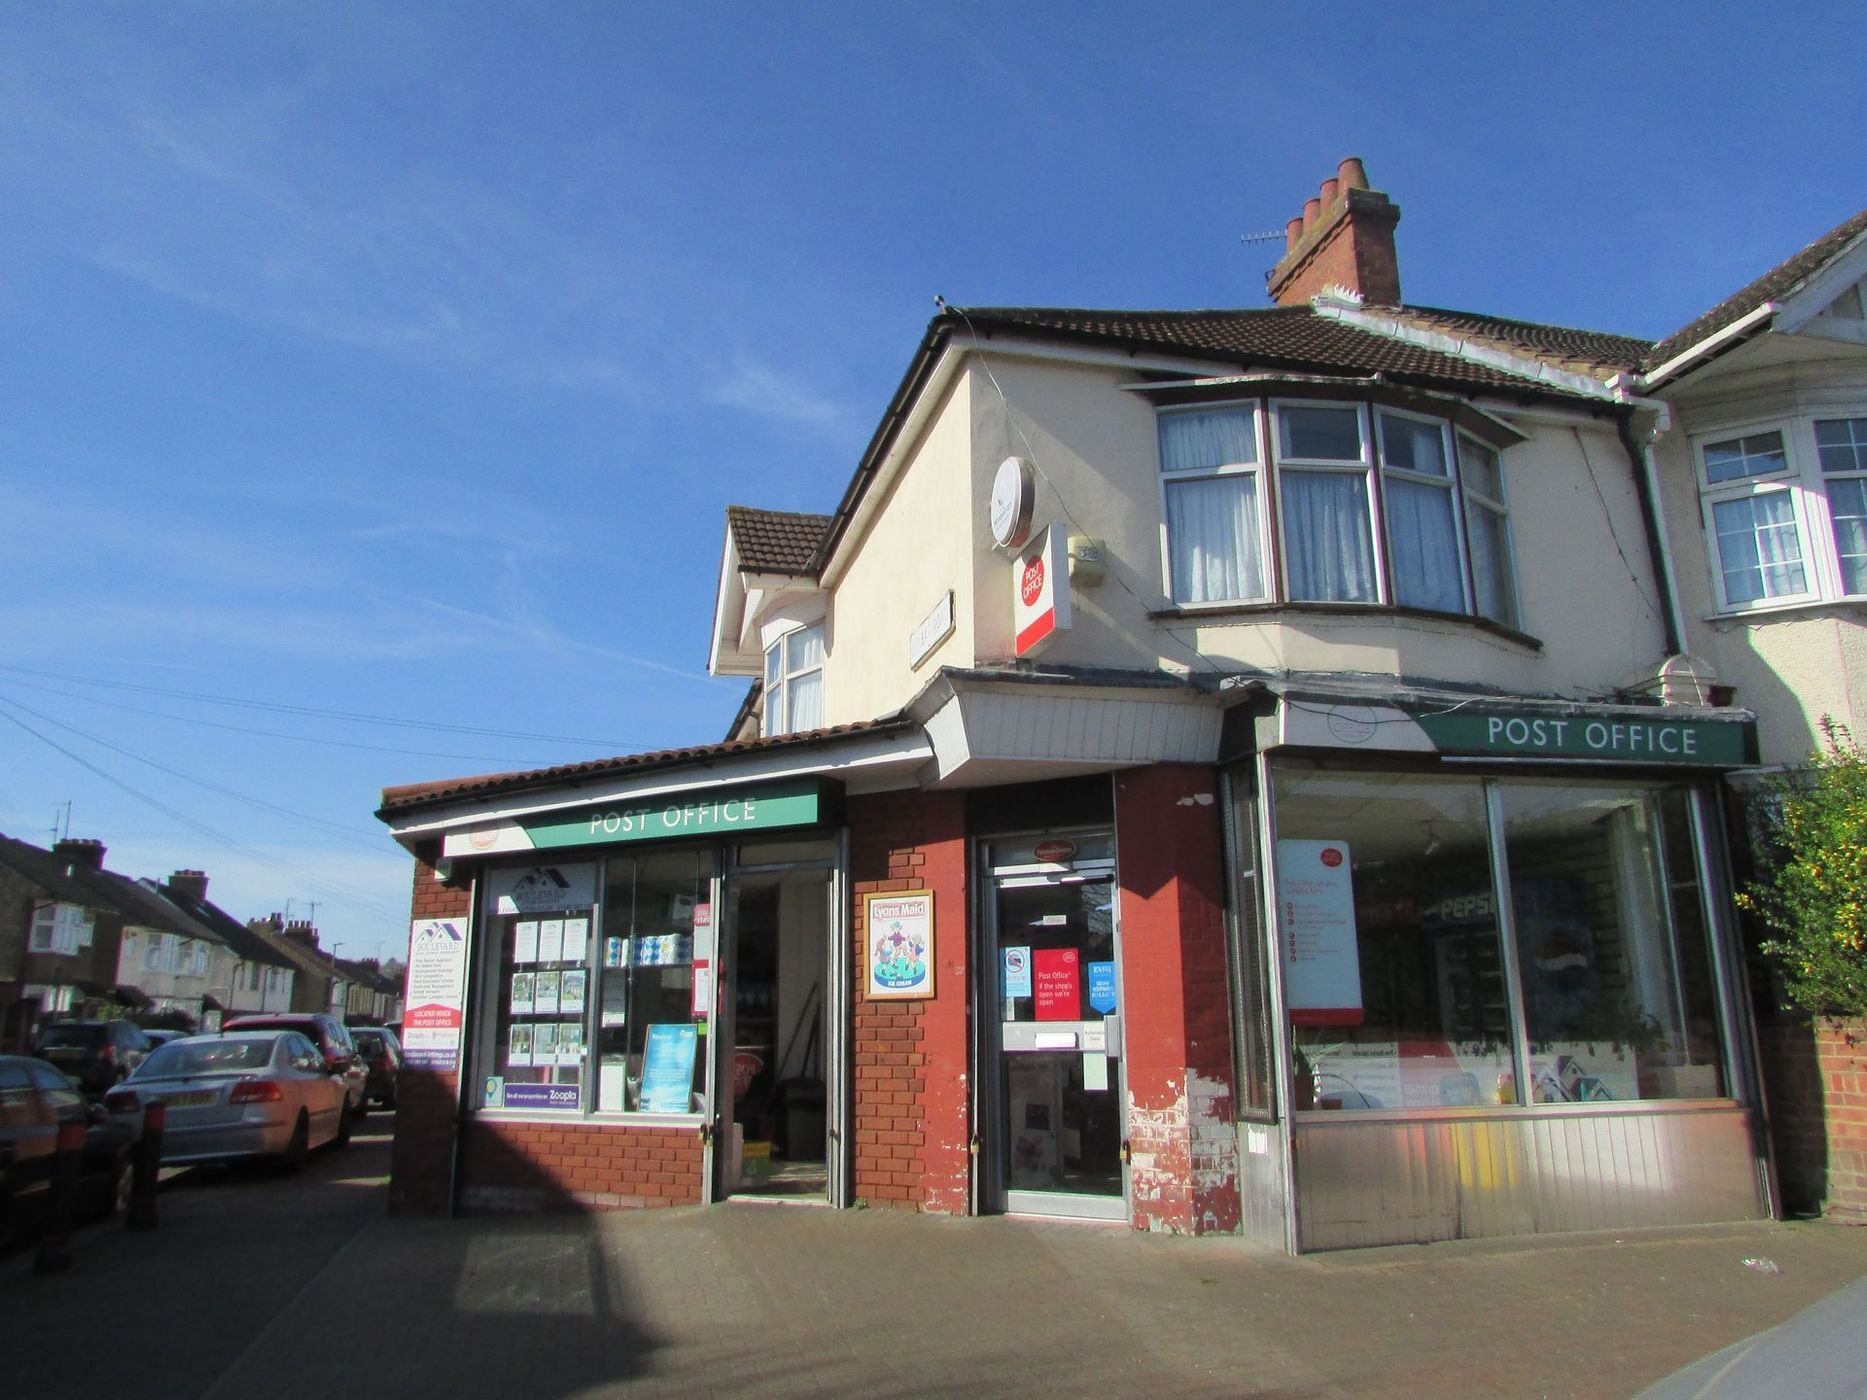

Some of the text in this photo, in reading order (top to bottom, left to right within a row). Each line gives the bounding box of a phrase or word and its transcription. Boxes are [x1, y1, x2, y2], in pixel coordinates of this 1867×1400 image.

[1025, 562, 1040, 582] POST
[1023, 574, 1042, 598] OFFICE
[1487, 717, 1698, 755] POST OFFICE
[589, 798, 757, 835] POST OFFICE
[874, 903, 924, 920] Lyons Maid
[1038, 972, 1050, 980] Post
[1055, 981, 1073, 991] shop's
[550, 1090, 577, 1101] Zoopla
